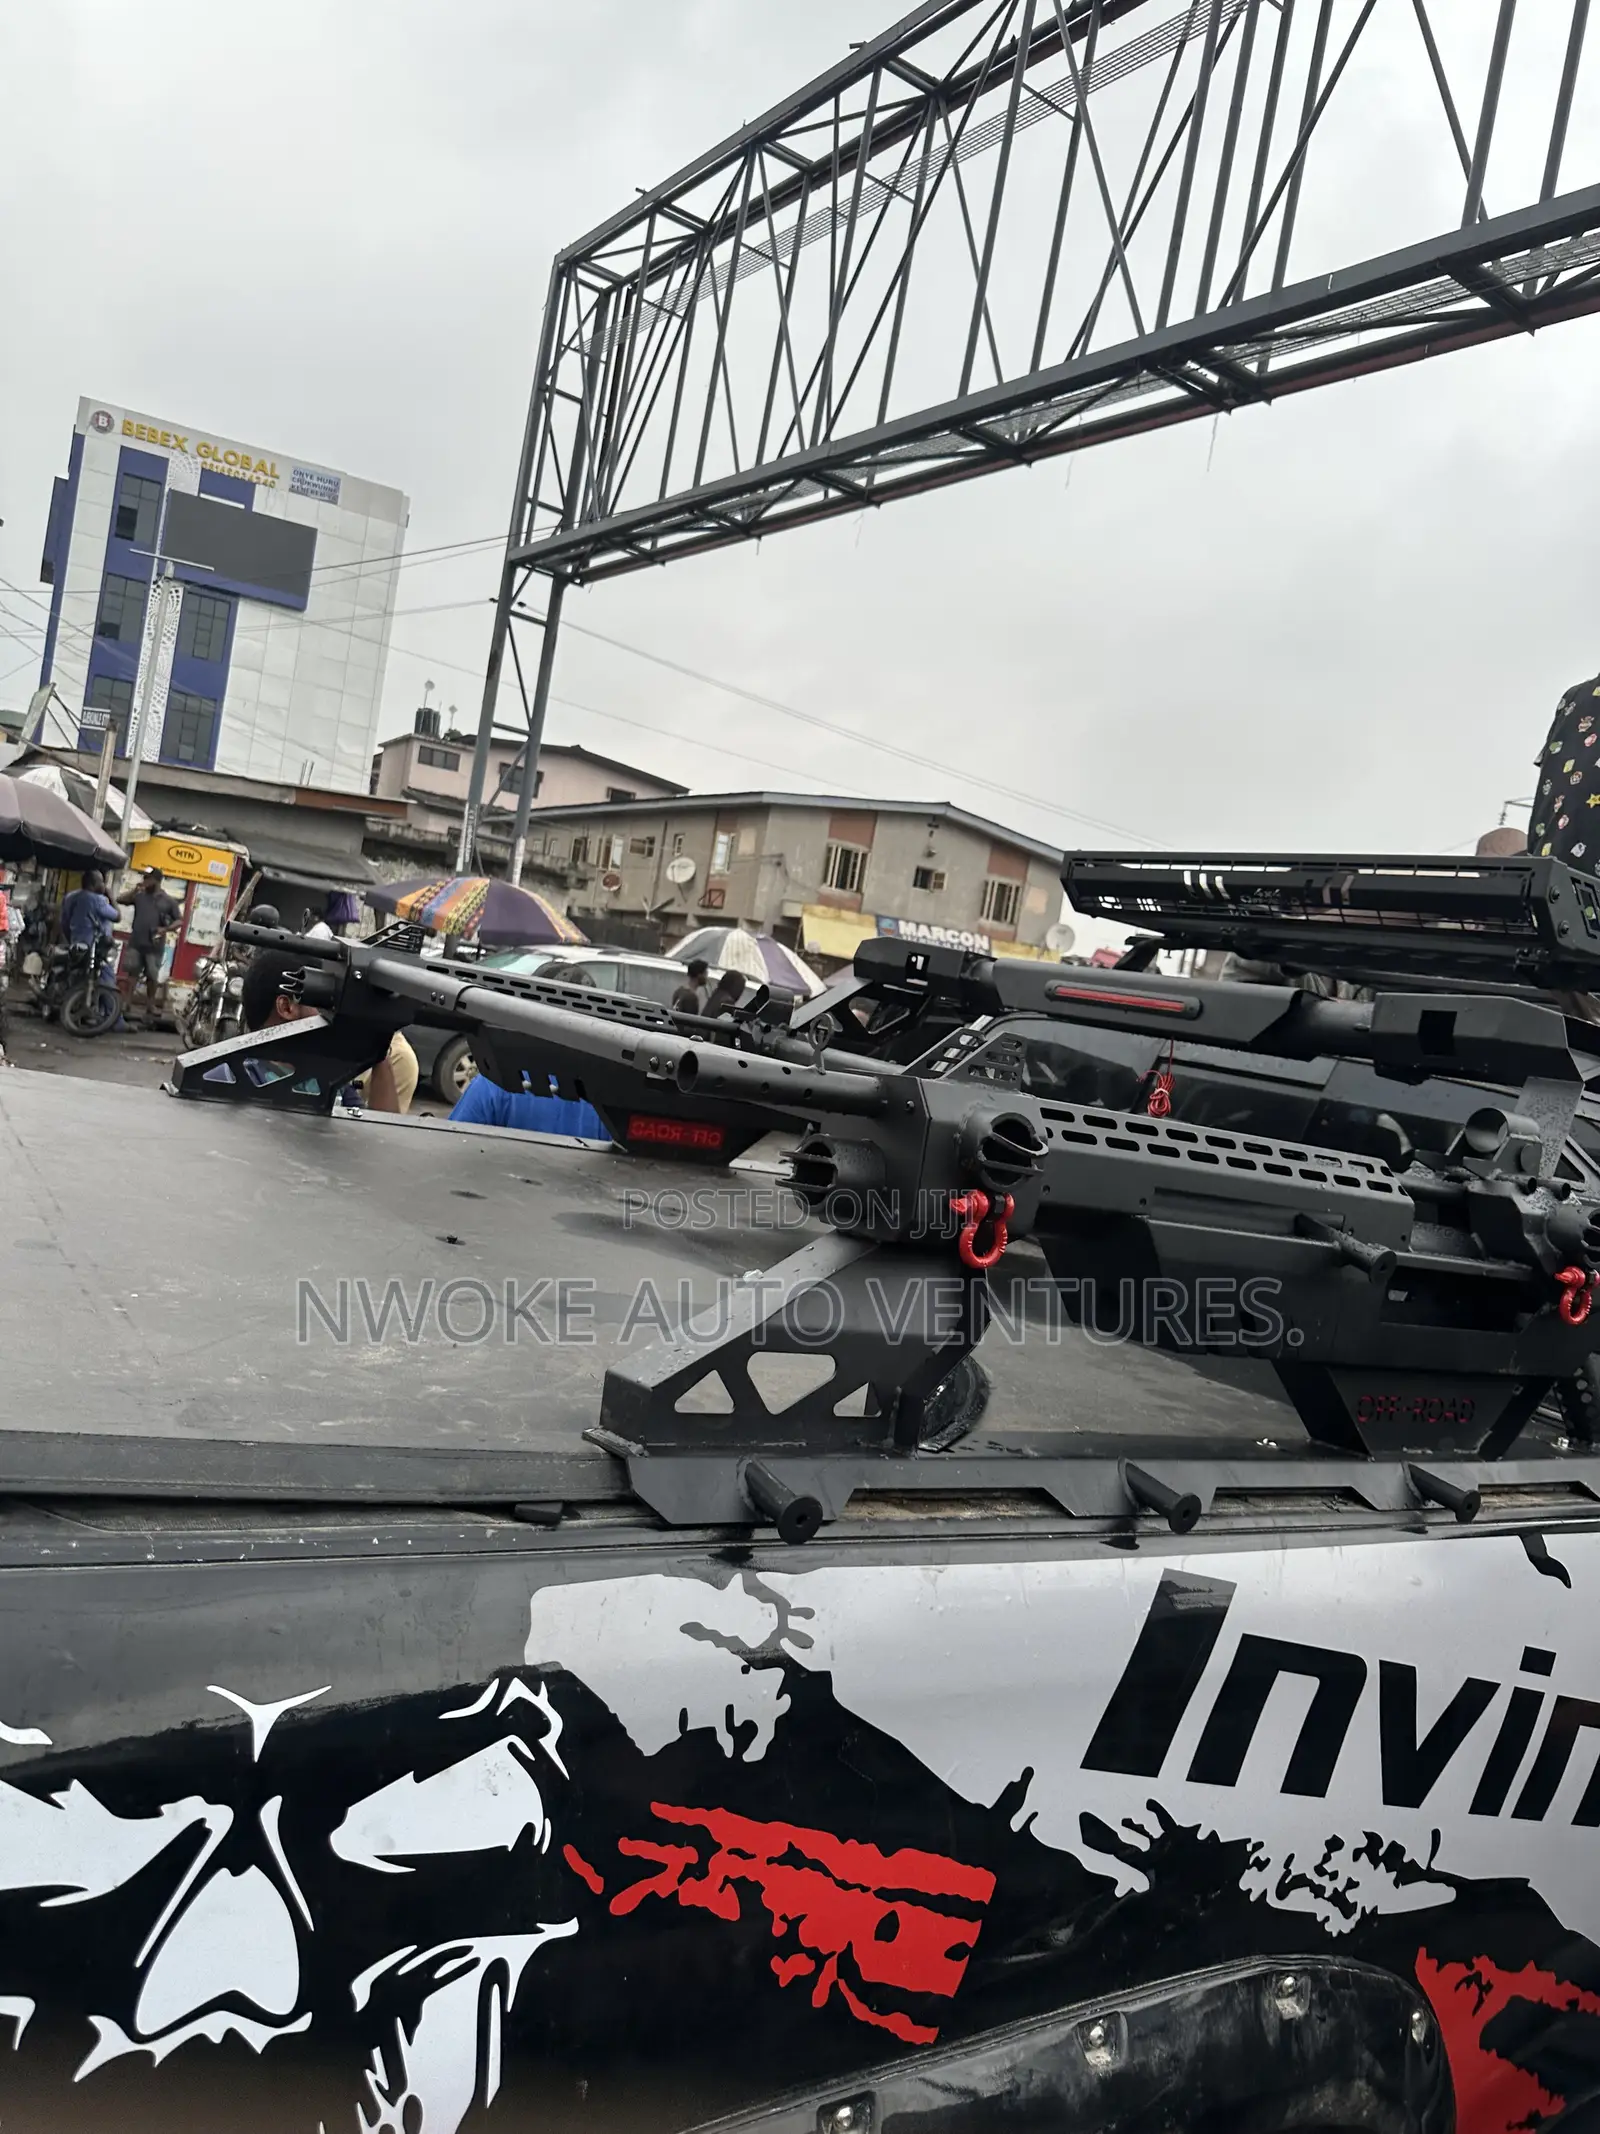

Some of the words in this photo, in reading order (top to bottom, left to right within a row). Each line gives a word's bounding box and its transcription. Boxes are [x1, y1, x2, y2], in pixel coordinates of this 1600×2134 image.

[121, 418, 189, 453] BEBEX
[196, 440, 280, 478] GLOBAL
[175, 849, 195, 860] MTN
[898, 919, 990, 950] MARCON
[1357, 1395, 1475, 1423] OFF-ROAD
